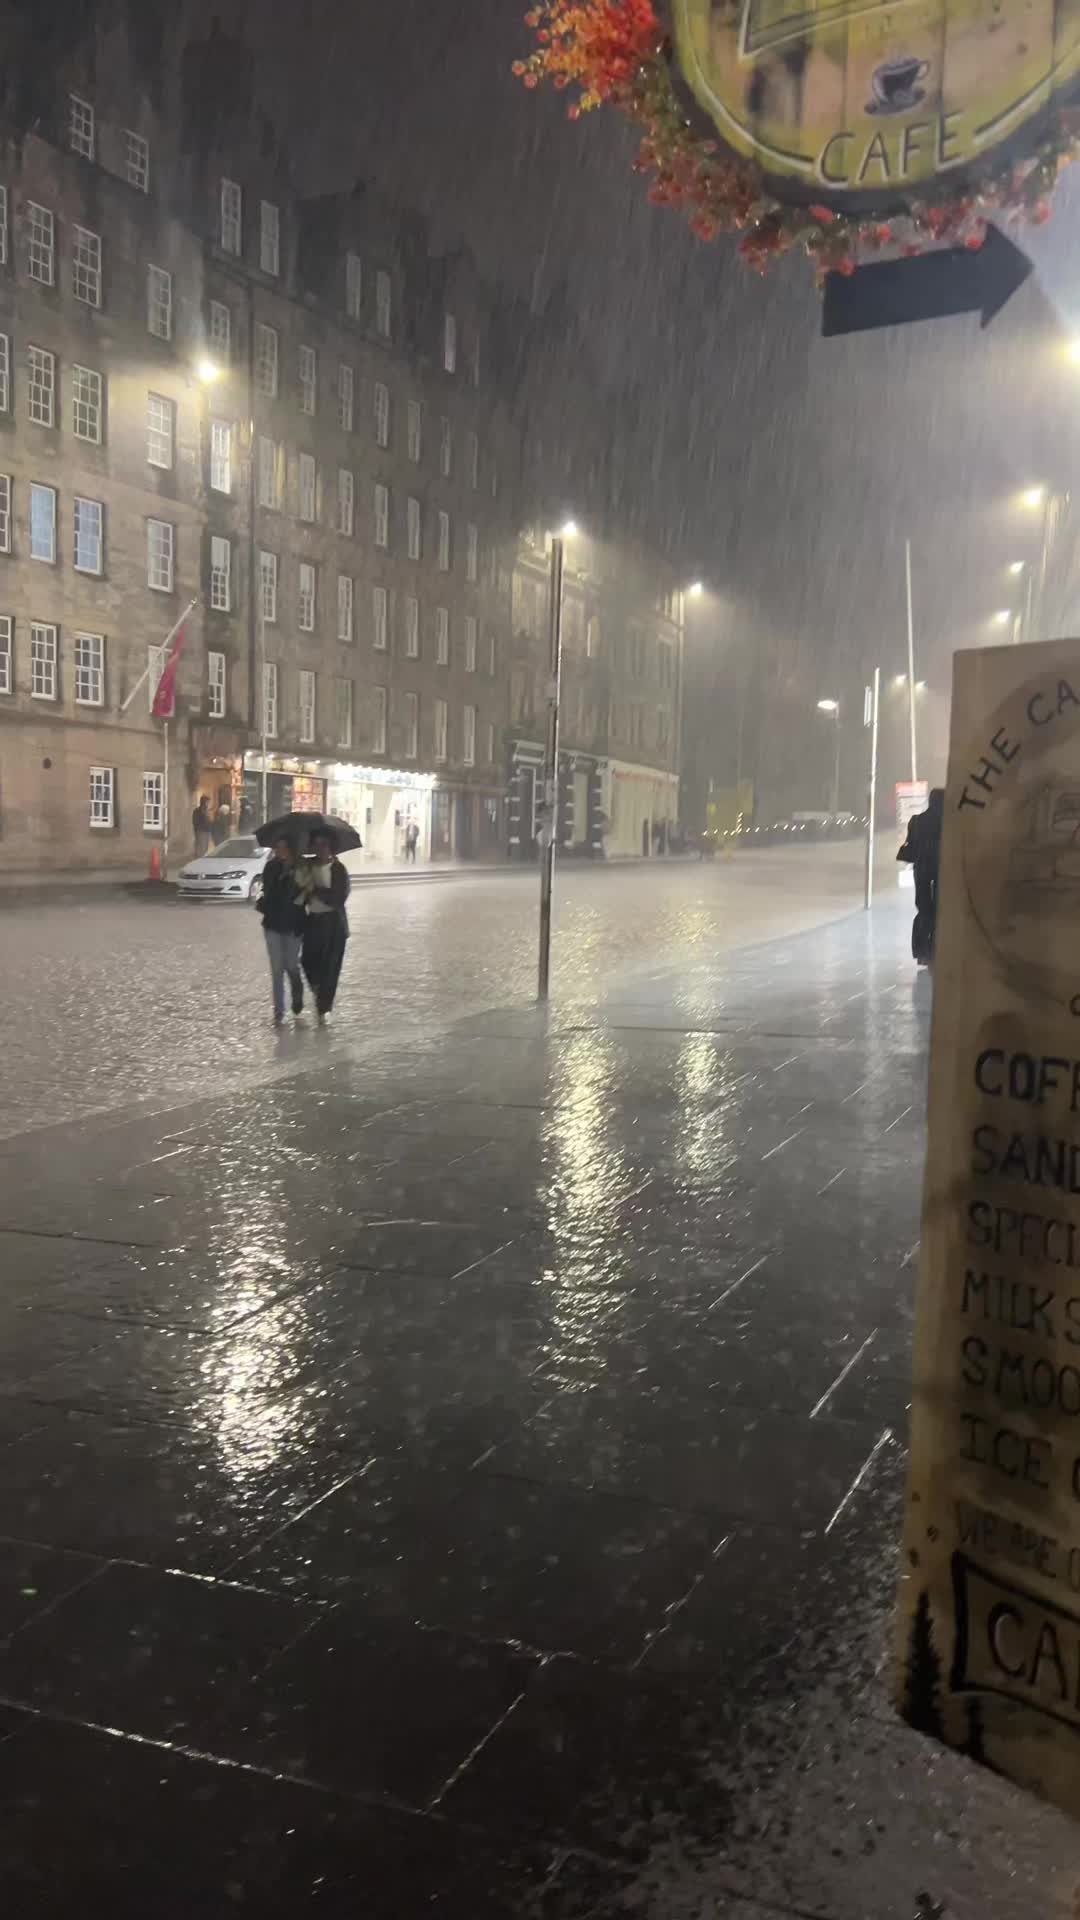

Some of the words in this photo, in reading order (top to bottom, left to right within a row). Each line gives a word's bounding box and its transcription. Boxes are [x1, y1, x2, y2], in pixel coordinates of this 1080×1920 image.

[816, 110, 964, 187] CAFE
[957, 726, 1021, 812] THE
[960, 1411, 1052, 1490] ICE
[987, 1602, 1080, 1711] CA
